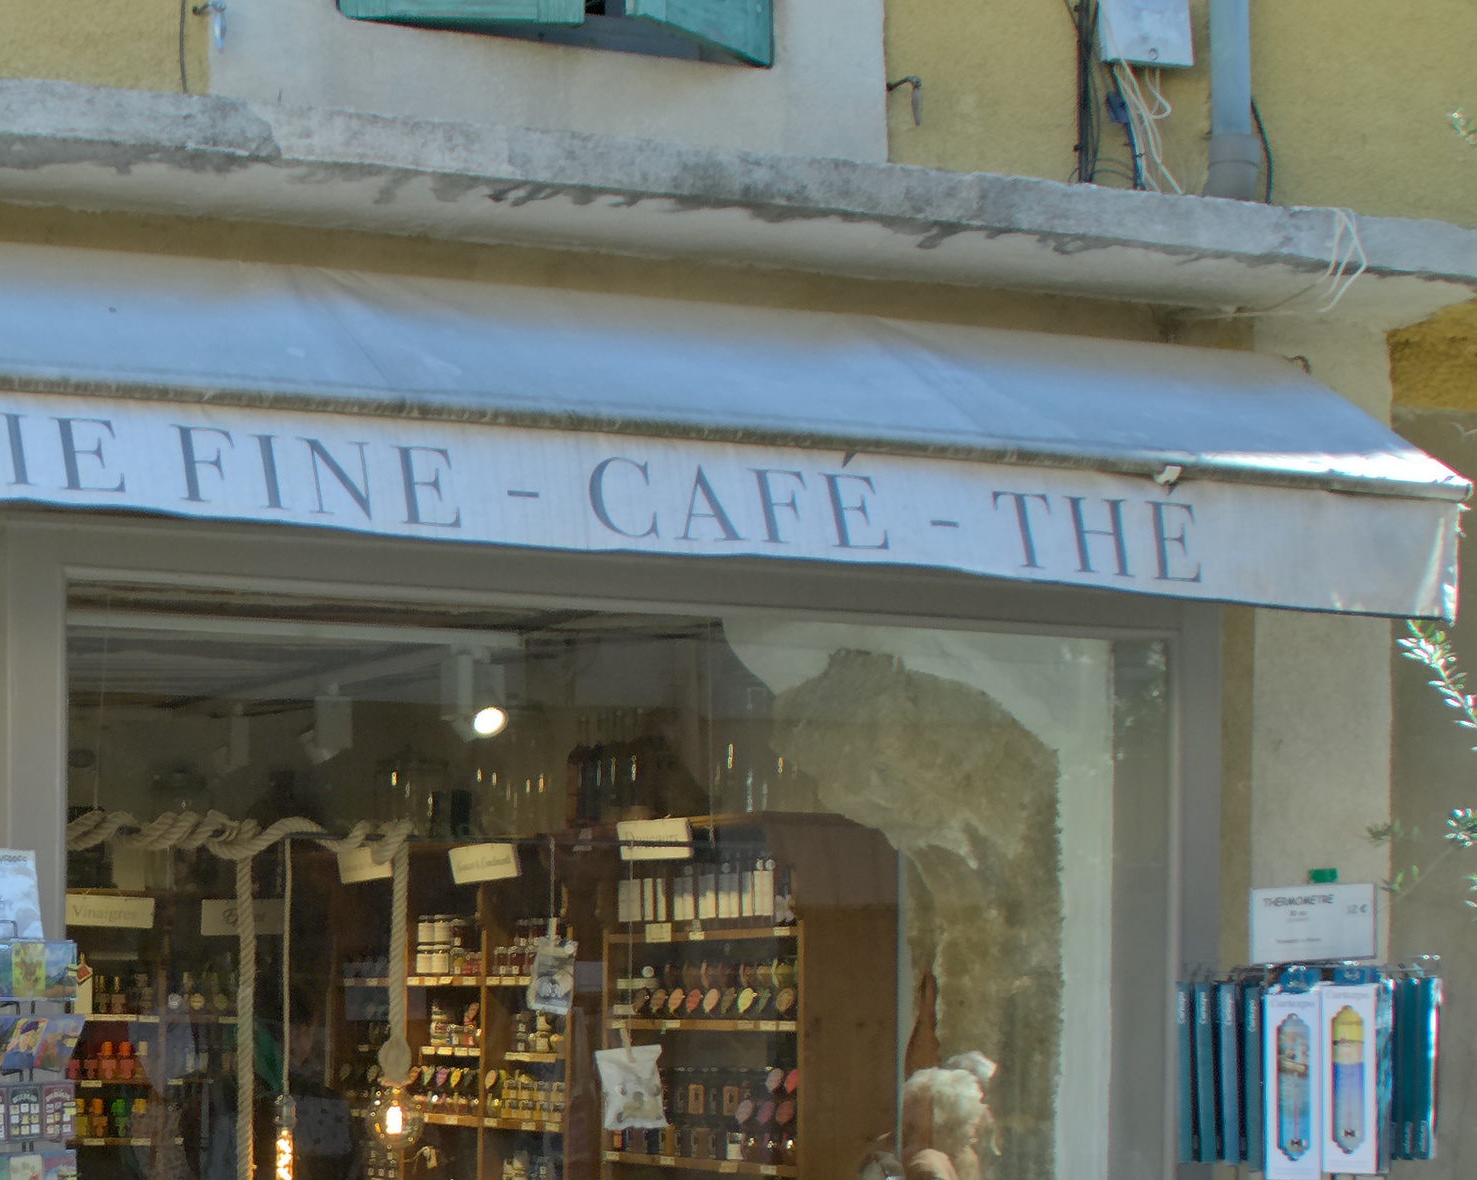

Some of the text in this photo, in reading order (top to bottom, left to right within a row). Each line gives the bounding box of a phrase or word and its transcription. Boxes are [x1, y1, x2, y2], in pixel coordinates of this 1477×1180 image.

[169, 423, 463, 530] FINE
[587, 451, 891, 551] CAFÉ
[991, 483, 1203, 584] THÉ
